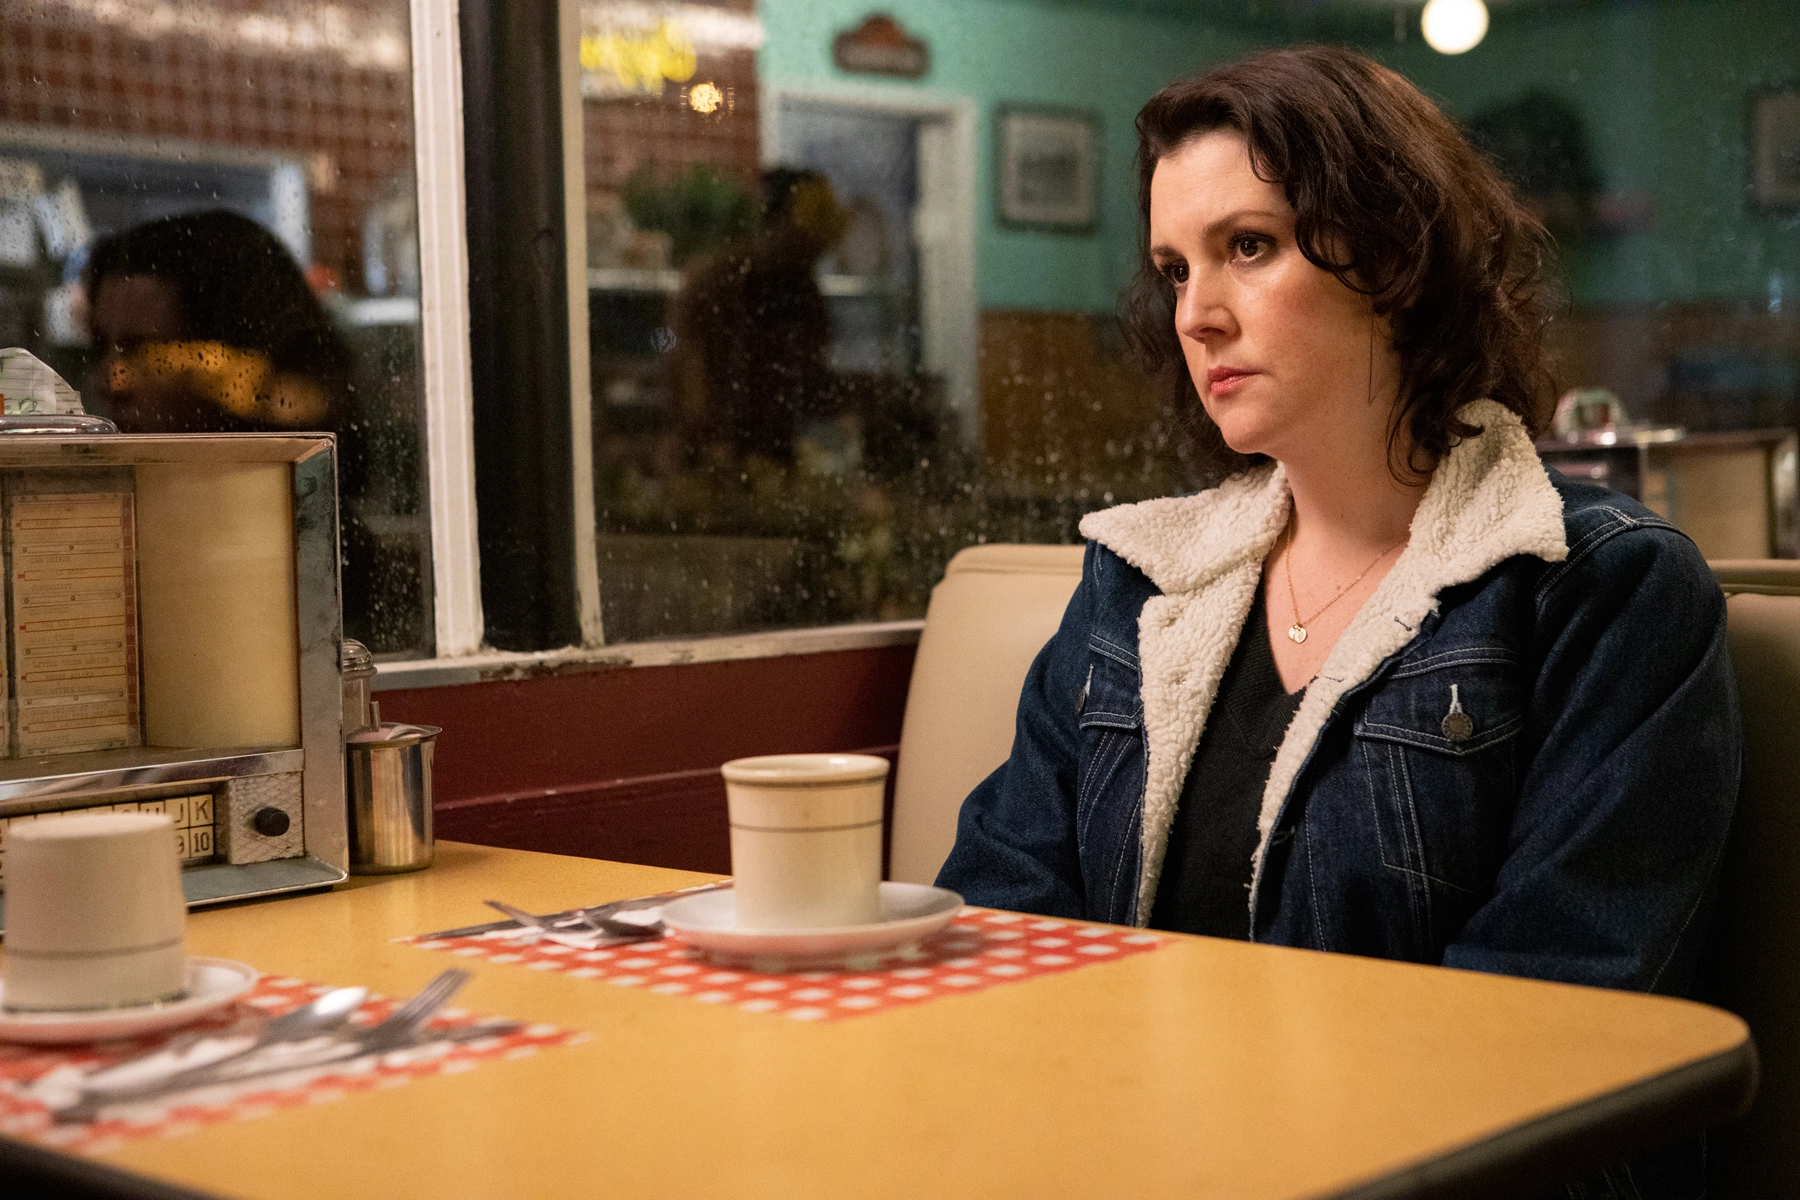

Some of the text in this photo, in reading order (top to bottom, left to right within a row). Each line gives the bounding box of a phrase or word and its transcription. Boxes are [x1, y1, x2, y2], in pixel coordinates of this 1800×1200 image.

[174, 803, 184, 823] J
[195, 800, 209, 820] K
[194, 832, 210, 853] 10
